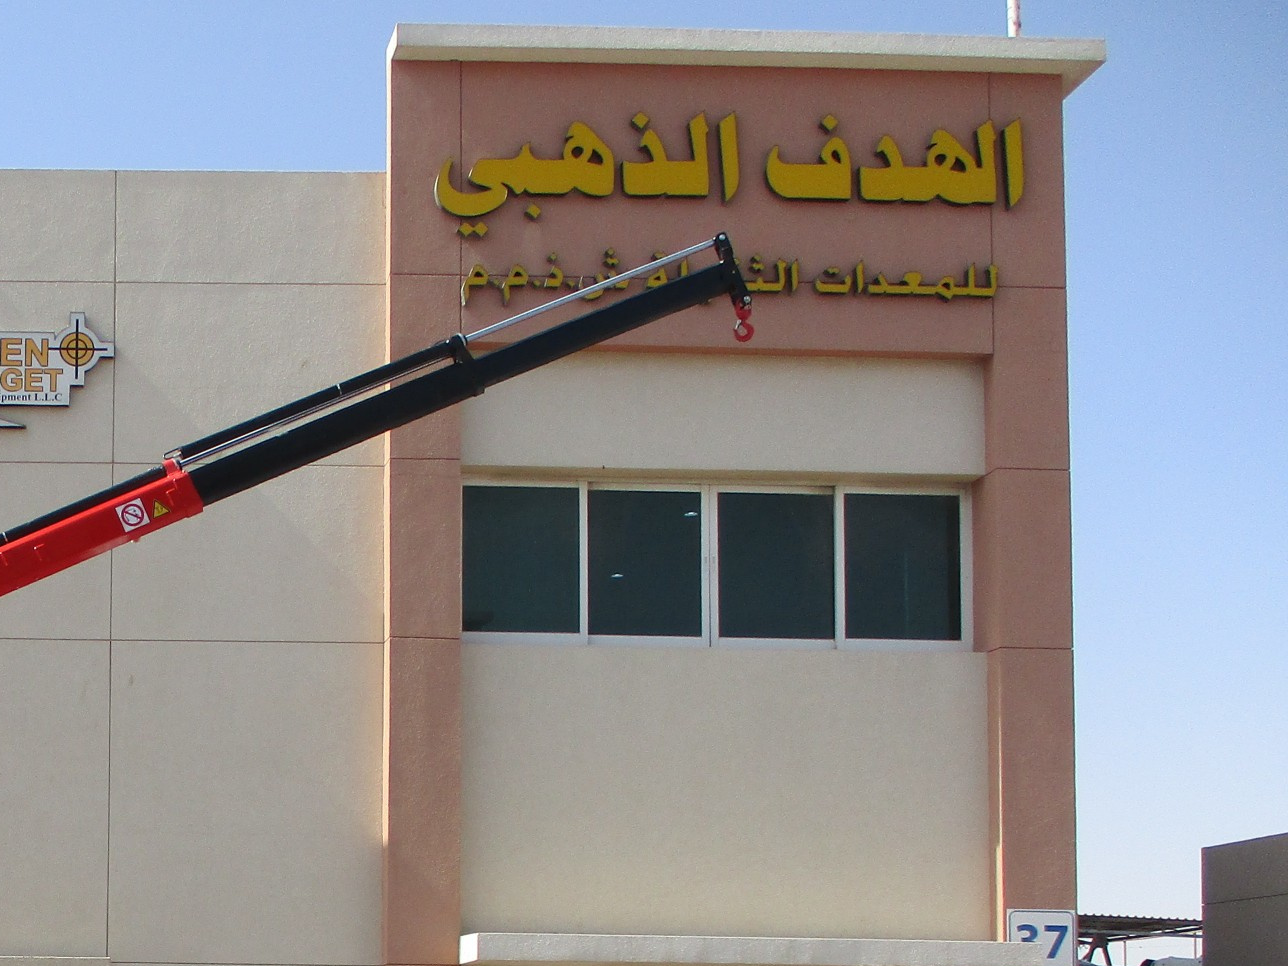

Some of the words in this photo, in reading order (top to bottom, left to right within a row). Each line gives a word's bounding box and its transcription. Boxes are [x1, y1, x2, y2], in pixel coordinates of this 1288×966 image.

[434, 110, 738, 238] الذهبي
[765, 113, 1024, 209] الهدف
[815, 260, 999, 301] للمعدات
[34, 393, 63, 402] L.L.C
[1016, 923, 1069, 959] 37
